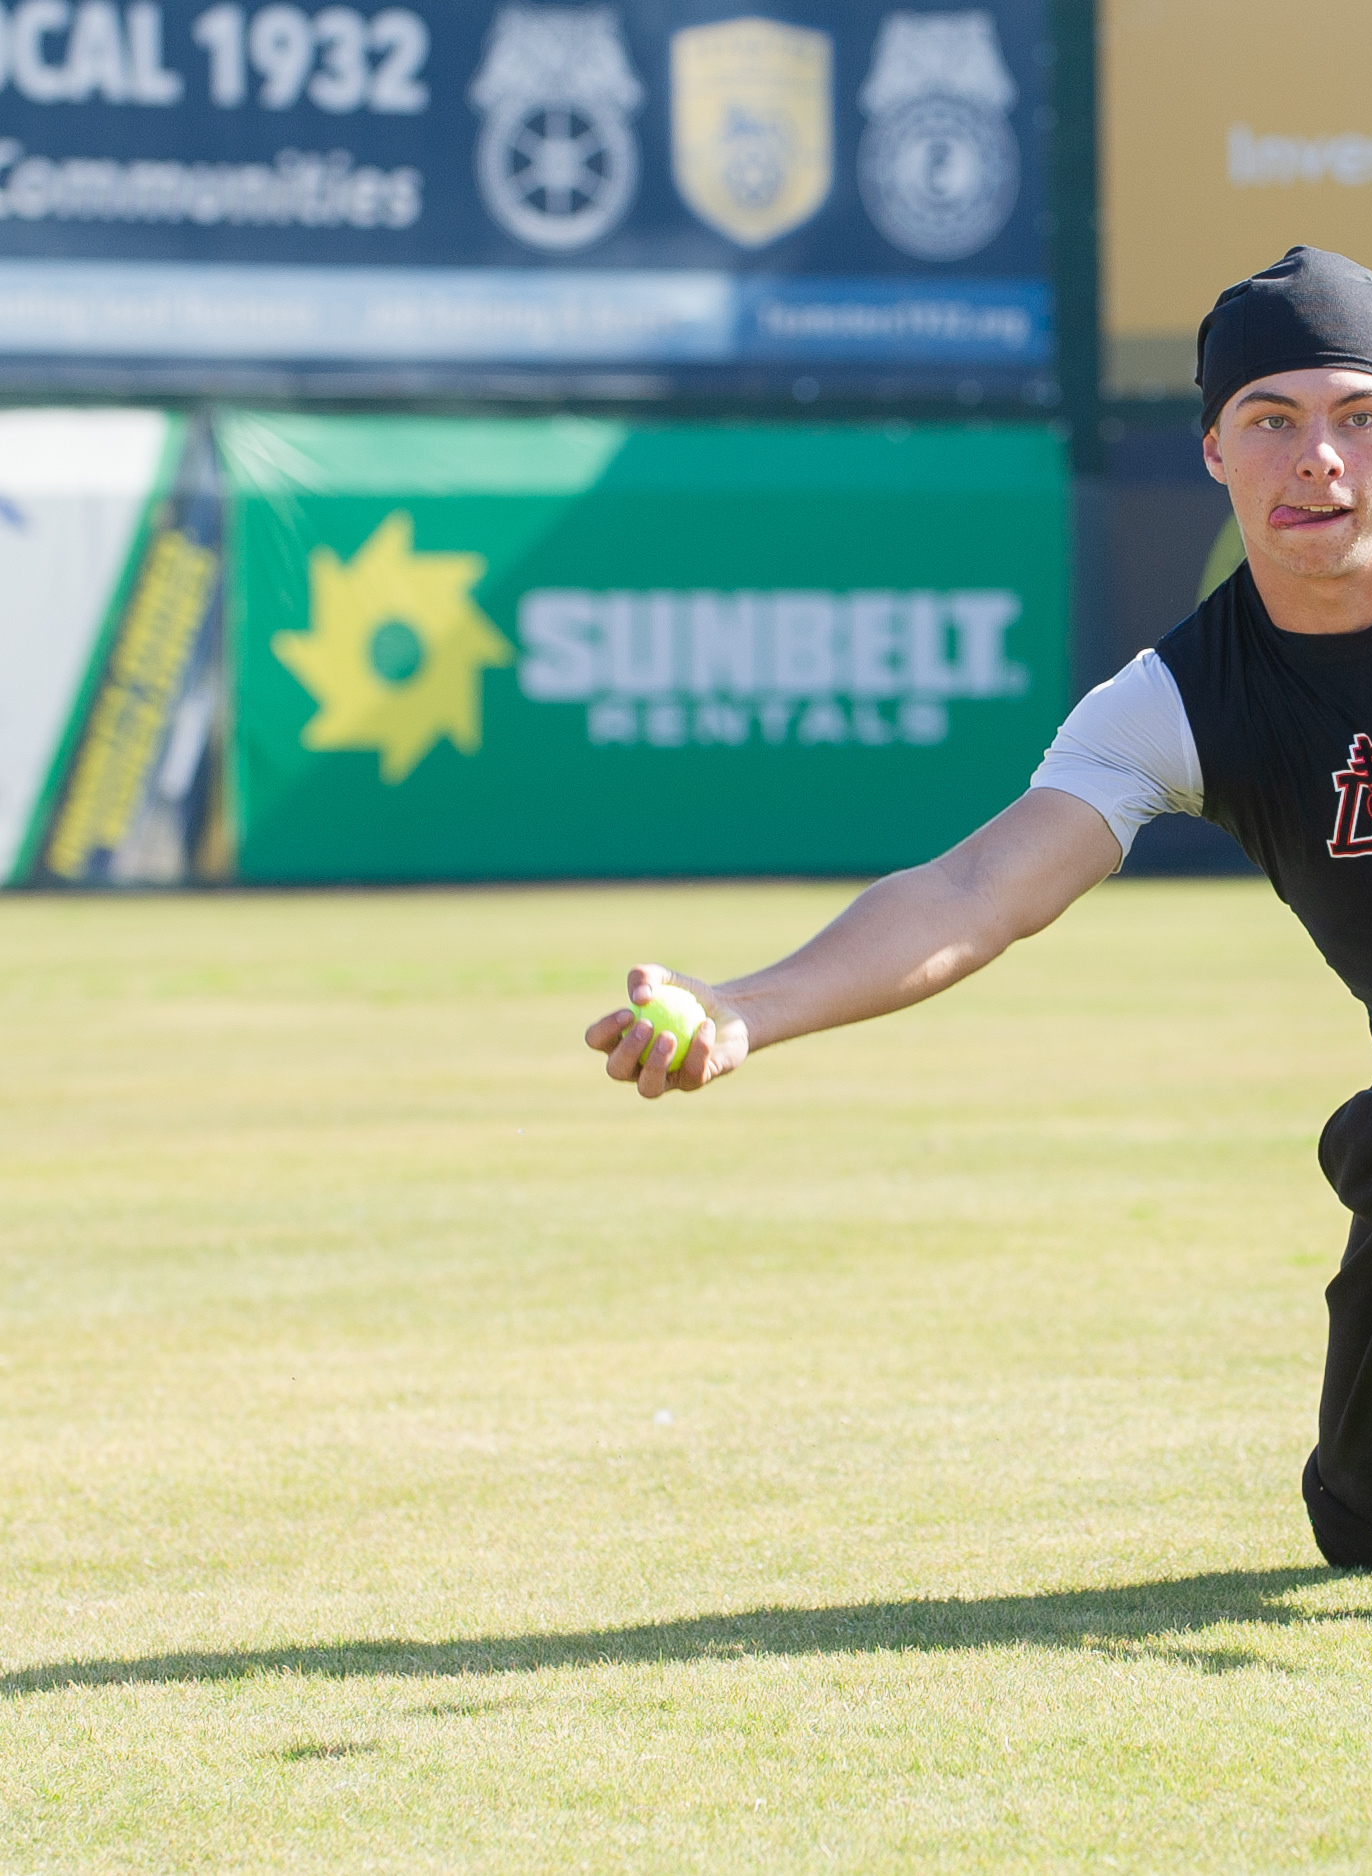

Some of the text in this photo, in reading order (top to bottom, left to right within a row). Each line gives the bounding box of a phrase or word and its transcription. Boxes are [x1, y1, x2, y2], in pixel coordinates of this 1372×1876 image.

[0, 0, 430, 113] CAL 1932
[586, 701, 950, 747] RENTALS
